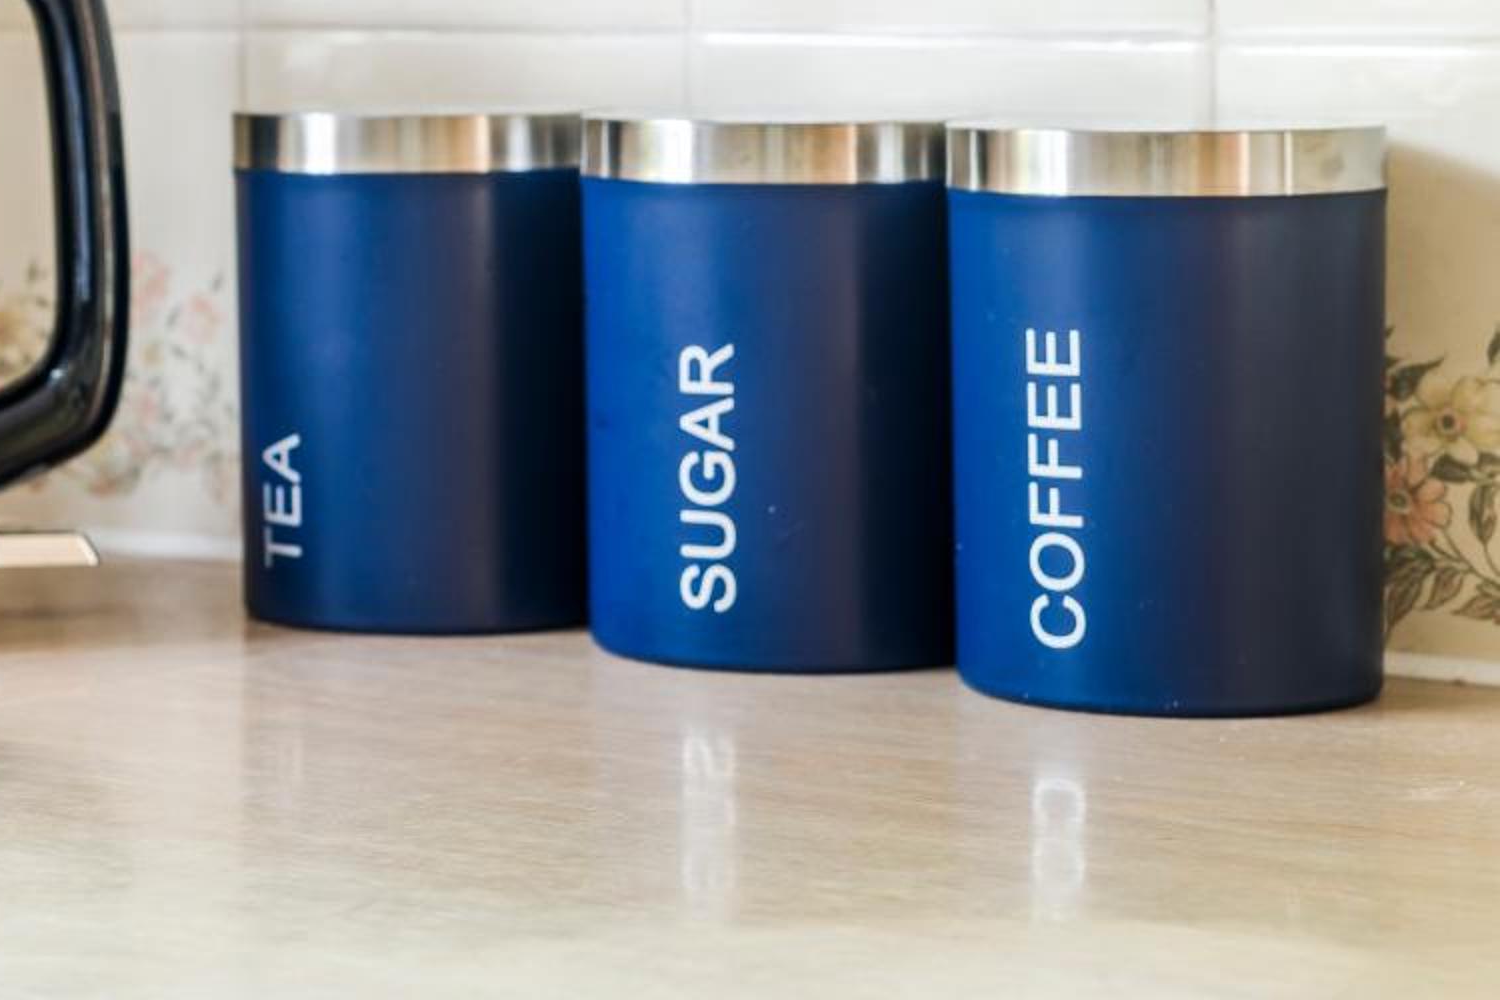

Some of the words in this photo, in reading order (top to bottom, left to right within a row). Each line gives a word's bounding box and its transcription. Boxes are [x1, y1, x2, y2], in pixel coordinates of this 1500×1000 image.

[263, 434, 301, 567] TEA
[678, 343, 737, 613] SUGAR
[1025, 327, 1086, 649] COFFEE
